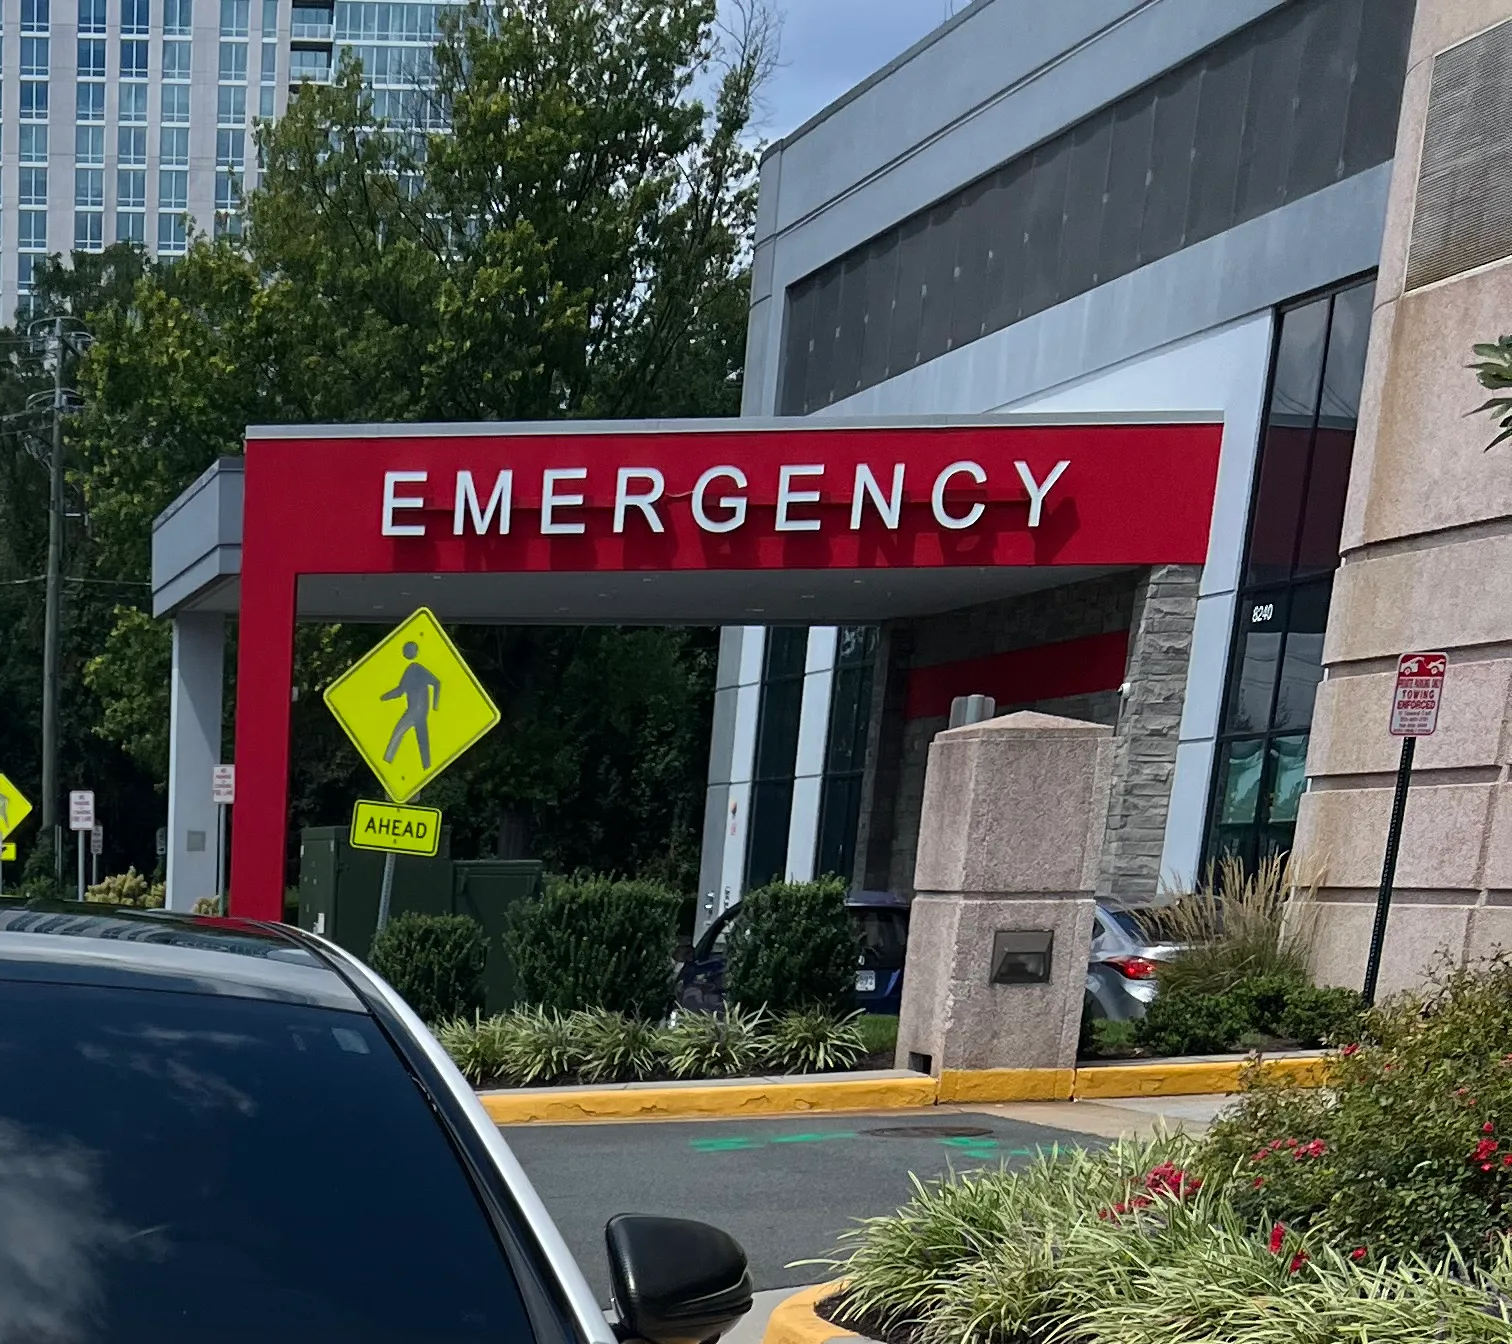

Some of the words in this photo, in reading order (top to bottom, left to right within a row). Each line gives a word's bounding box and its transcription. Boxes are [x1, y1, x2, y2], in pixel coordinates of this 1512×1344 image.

[381, 460, 1071, 536] EMERGENCY
[1252, 603, 1274, 623] 8240
[1402, 689, 1435, 699] TOWING
[364, 816, 427, 839] AHEAD
